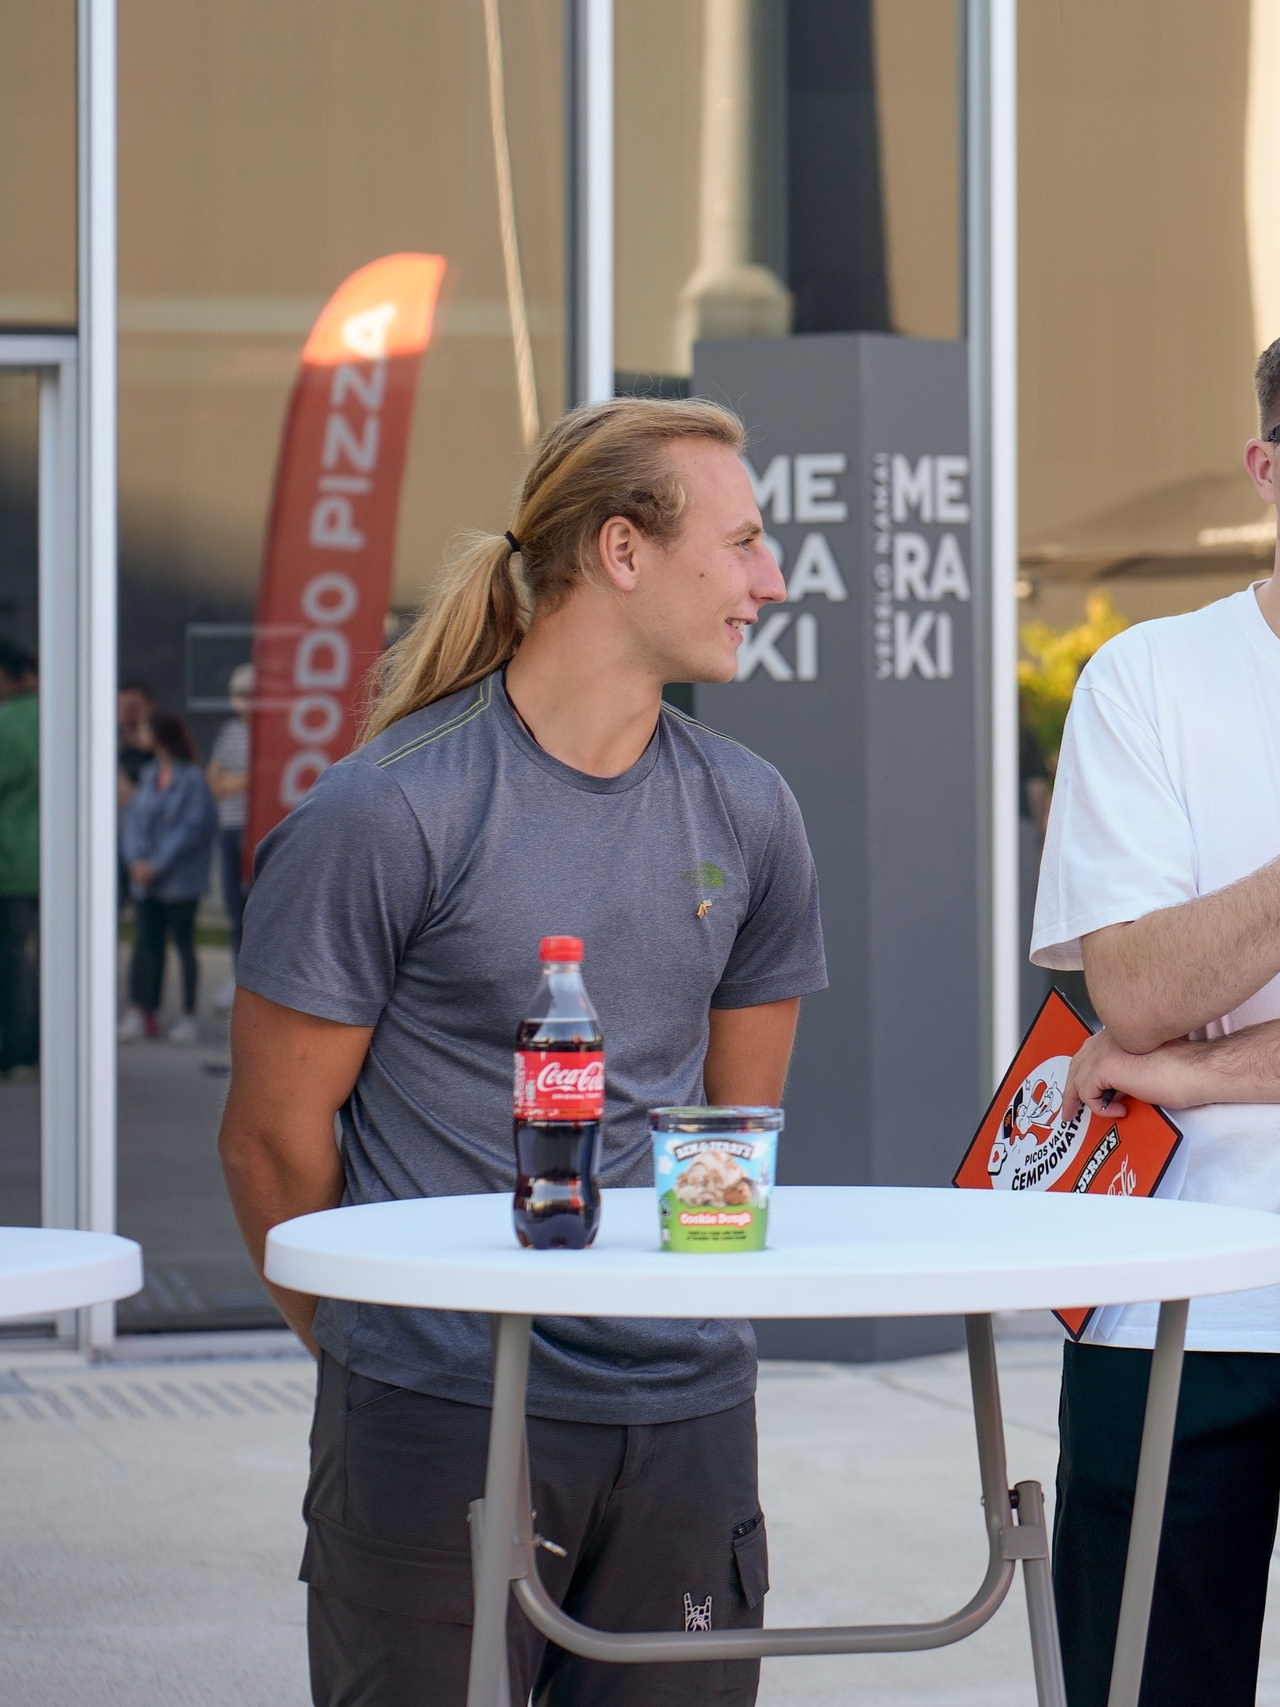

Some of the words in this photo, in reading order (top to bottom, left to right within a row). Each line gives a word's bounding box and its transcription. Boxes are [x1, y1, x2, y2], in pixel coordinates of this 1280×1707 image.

[308, 301, 397, 550] PIZZA
[873, 453, 892, 554] NAMAI
[891, 453, 969, 524] ME
[764, 532, 848, 602] A
[892, 532, 971, 602] RA
[735, 611, 818, 682] KI
[874, 562, 893, 681] VERSLO
[893, 610, 953, 680] KI
[537, 1061, 604, 1092] Coca-Col
[1011, 1101, 1086, 1191] ČEMPIONATA
[1024, 1143, 1048, 1167] PICOS
[1049, 1121, 1068, 1149] VALG
[680, 1212, 717, 1225] Cookie
[717, 1212, 752, 1227] Dough
